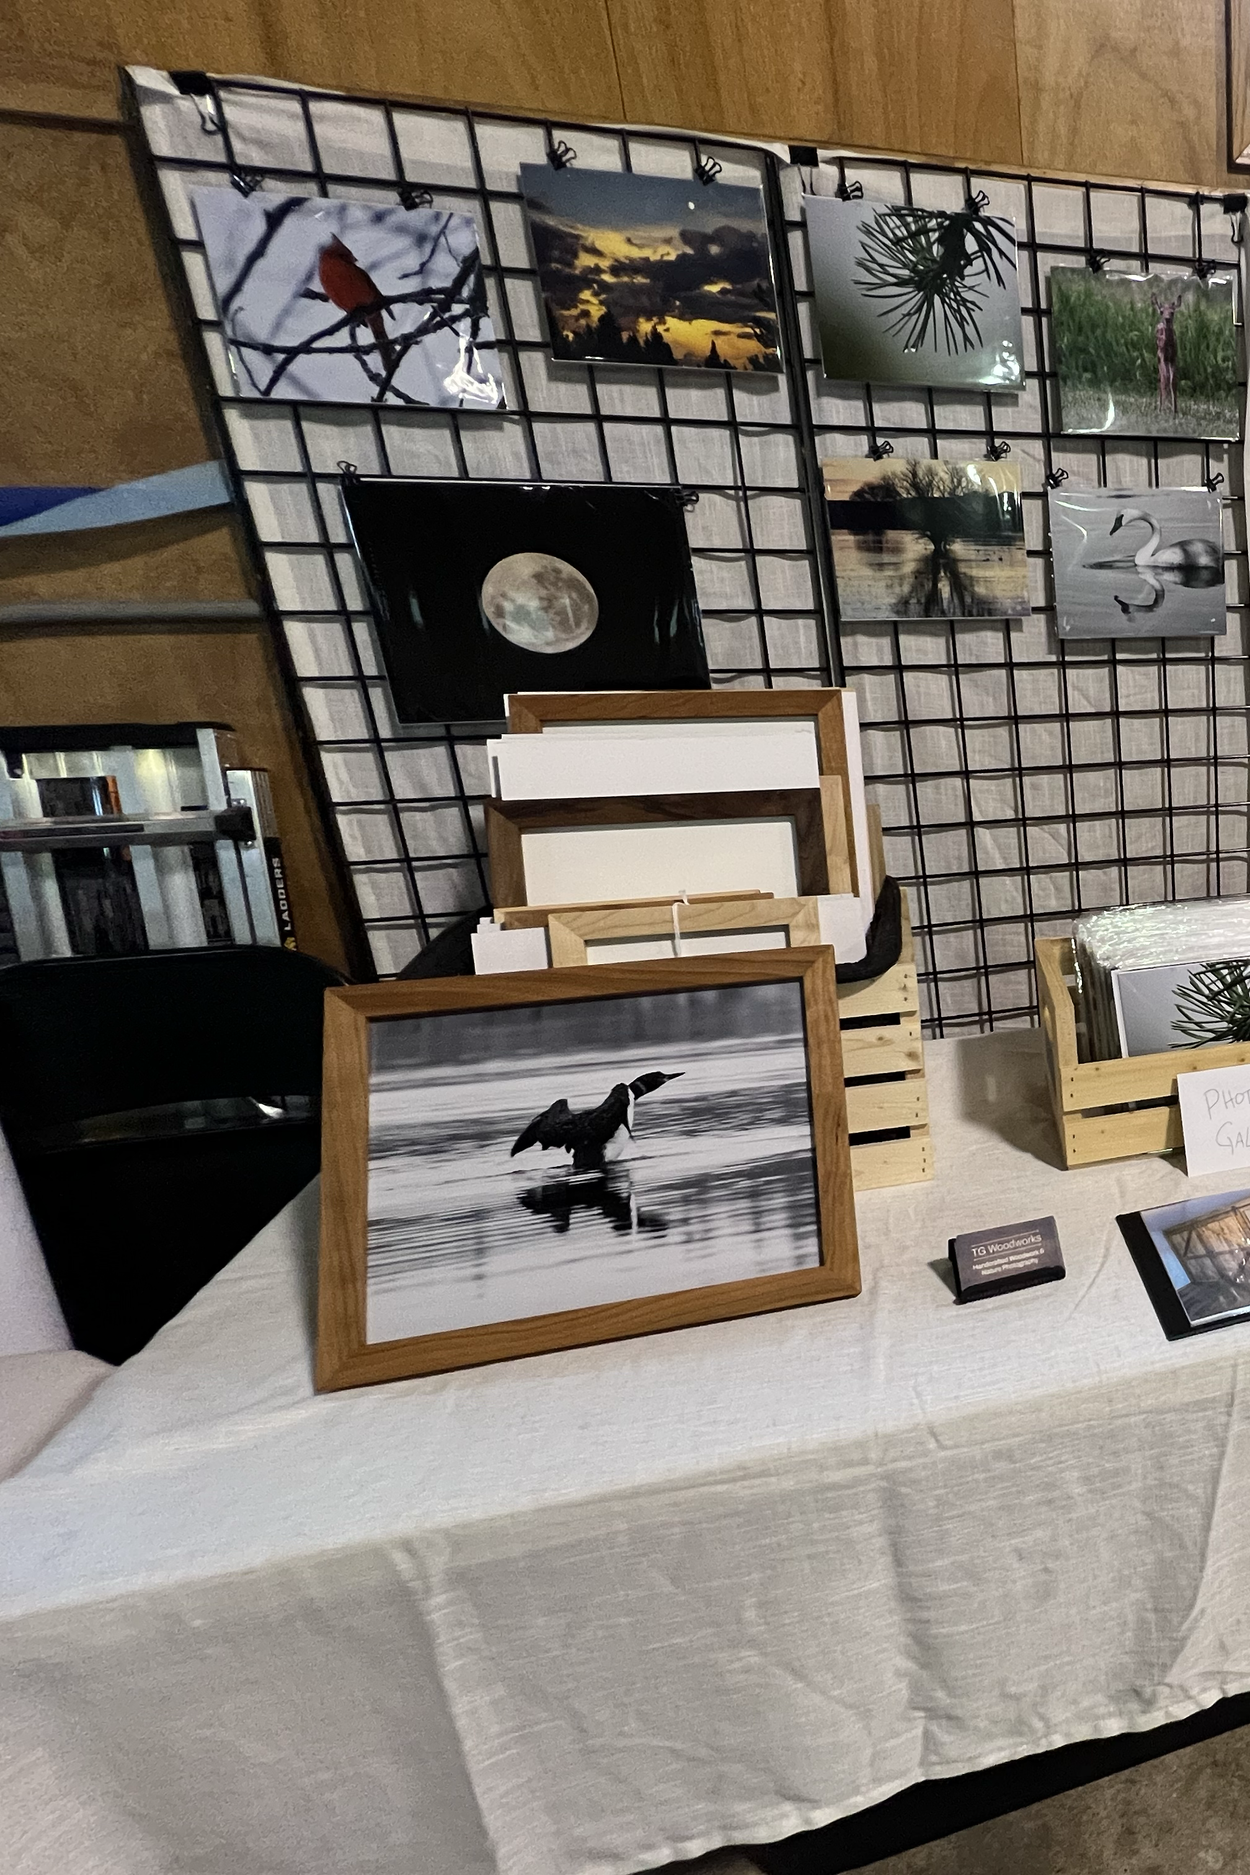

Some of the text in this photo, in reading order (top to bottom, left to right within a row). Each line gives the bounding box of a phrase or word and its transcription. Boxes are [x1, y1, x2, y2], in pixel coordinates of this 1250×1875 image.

[272, 857, 291, 931] LADDERS
[971, 1234, 1042, 1257] TG Woodworks
